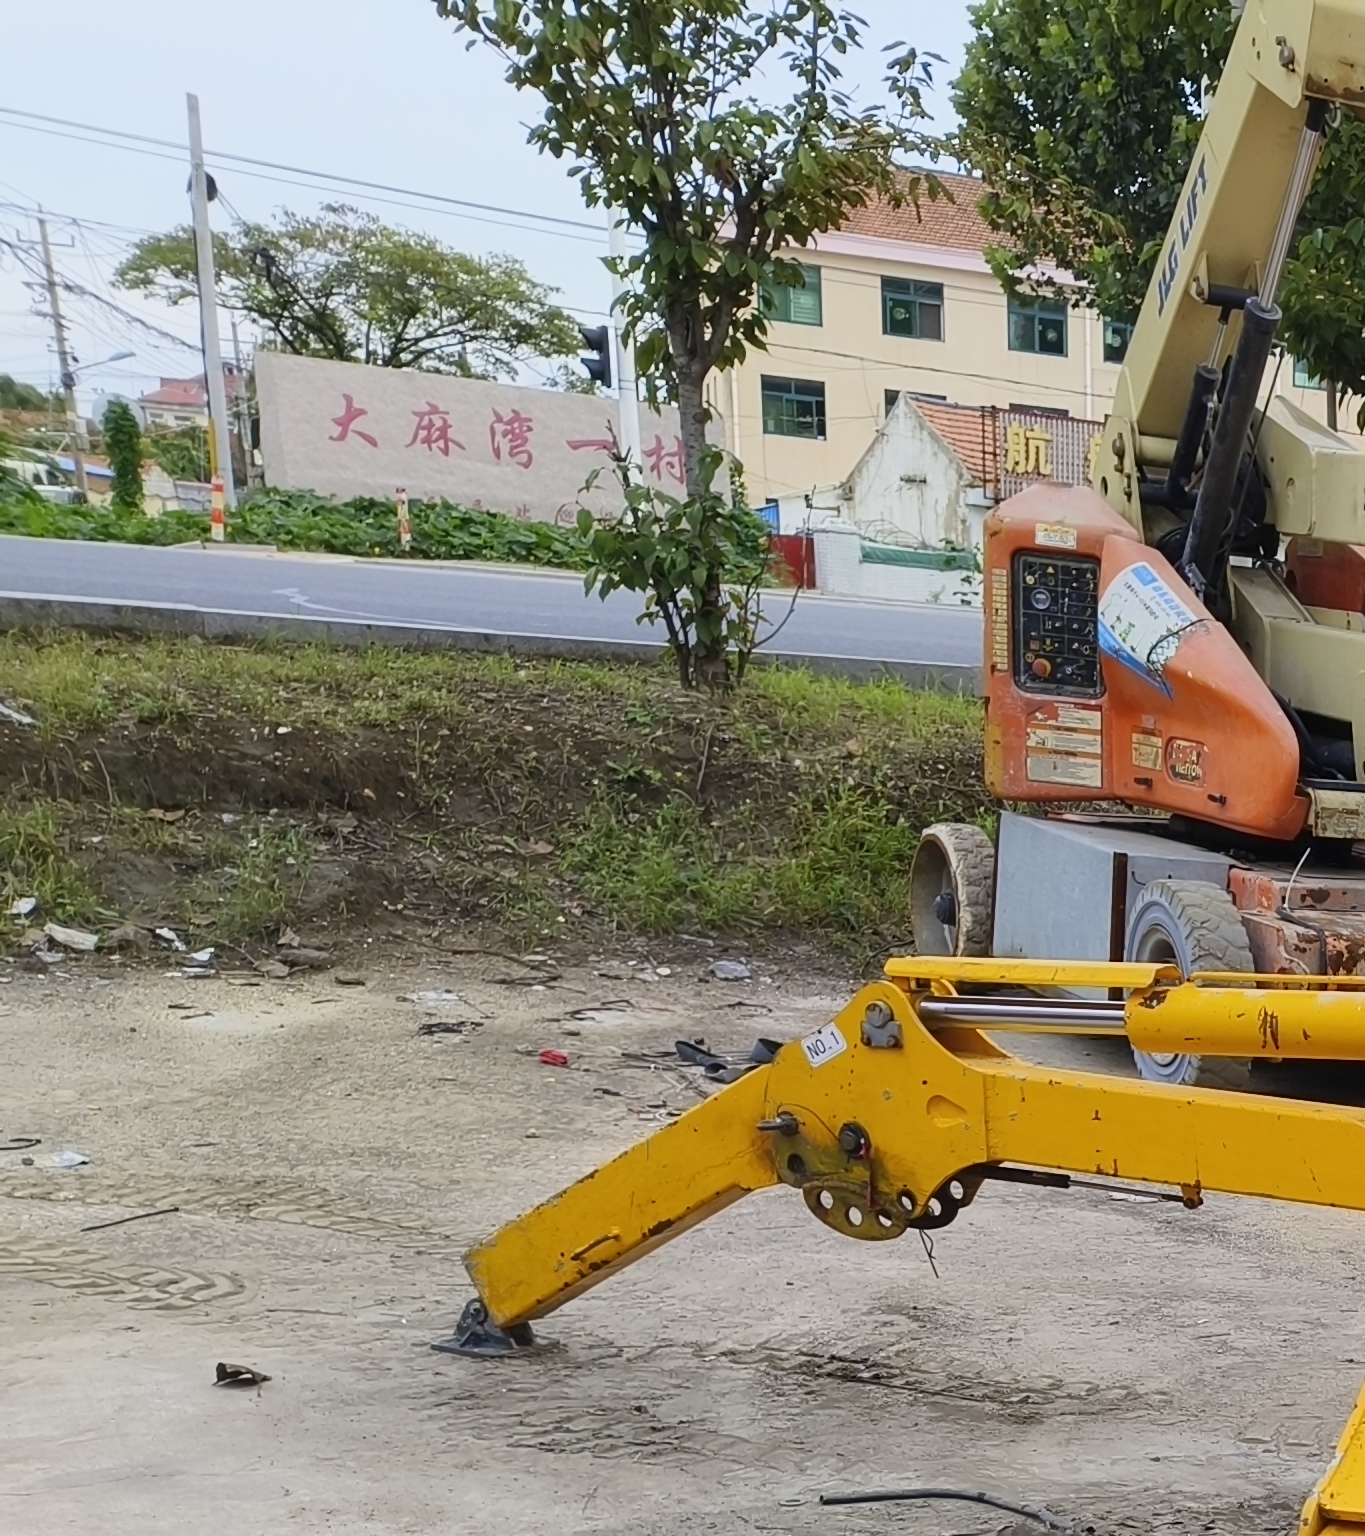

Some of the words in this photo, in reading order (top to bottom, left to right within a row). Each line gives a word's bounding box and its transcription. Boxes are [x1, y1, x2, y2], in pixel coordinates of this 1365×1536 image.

[1179, 153, 1208, 252] LIFT
[327, 393, 687, 486] 大麻湾一村
